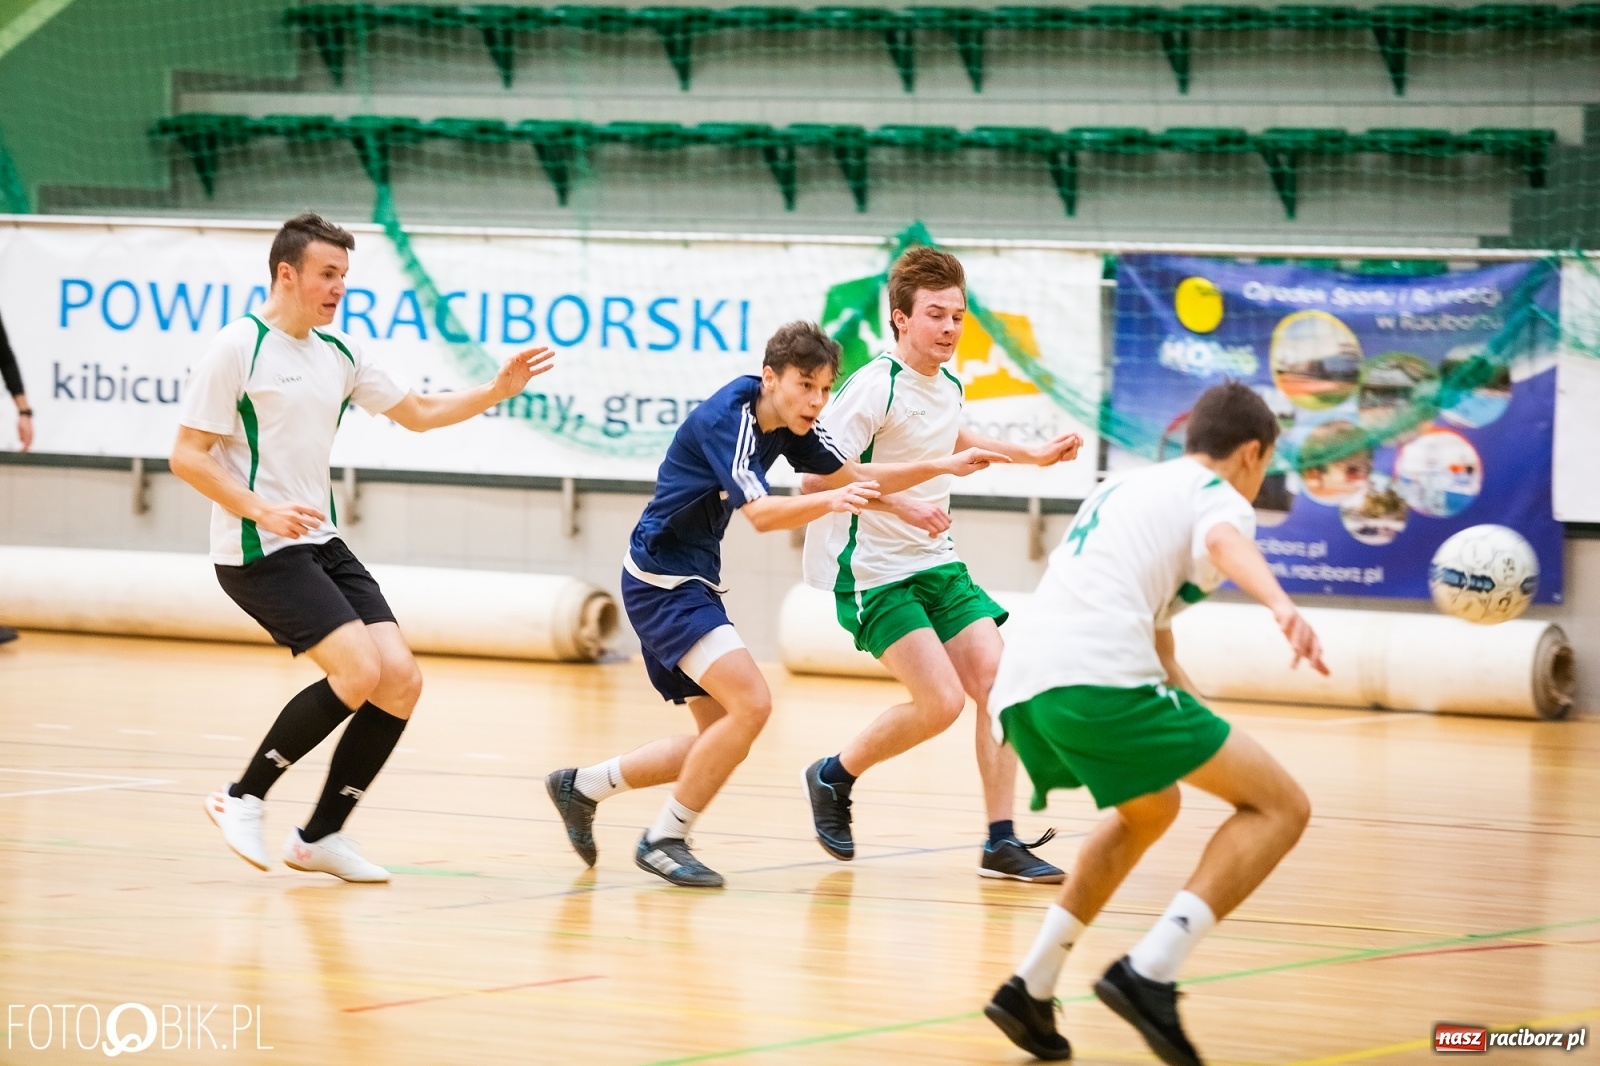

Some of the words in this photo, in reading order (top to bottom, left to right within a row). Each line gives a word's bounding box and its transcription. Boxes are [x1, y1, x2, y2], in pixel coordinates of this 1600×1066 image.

[59, 279, 267, 332] POWIA
[341, 287, 751, 352] RACIBORSKI
[53, 362, 191, 403] kibicu
[602, 393, 706, 438] gra
